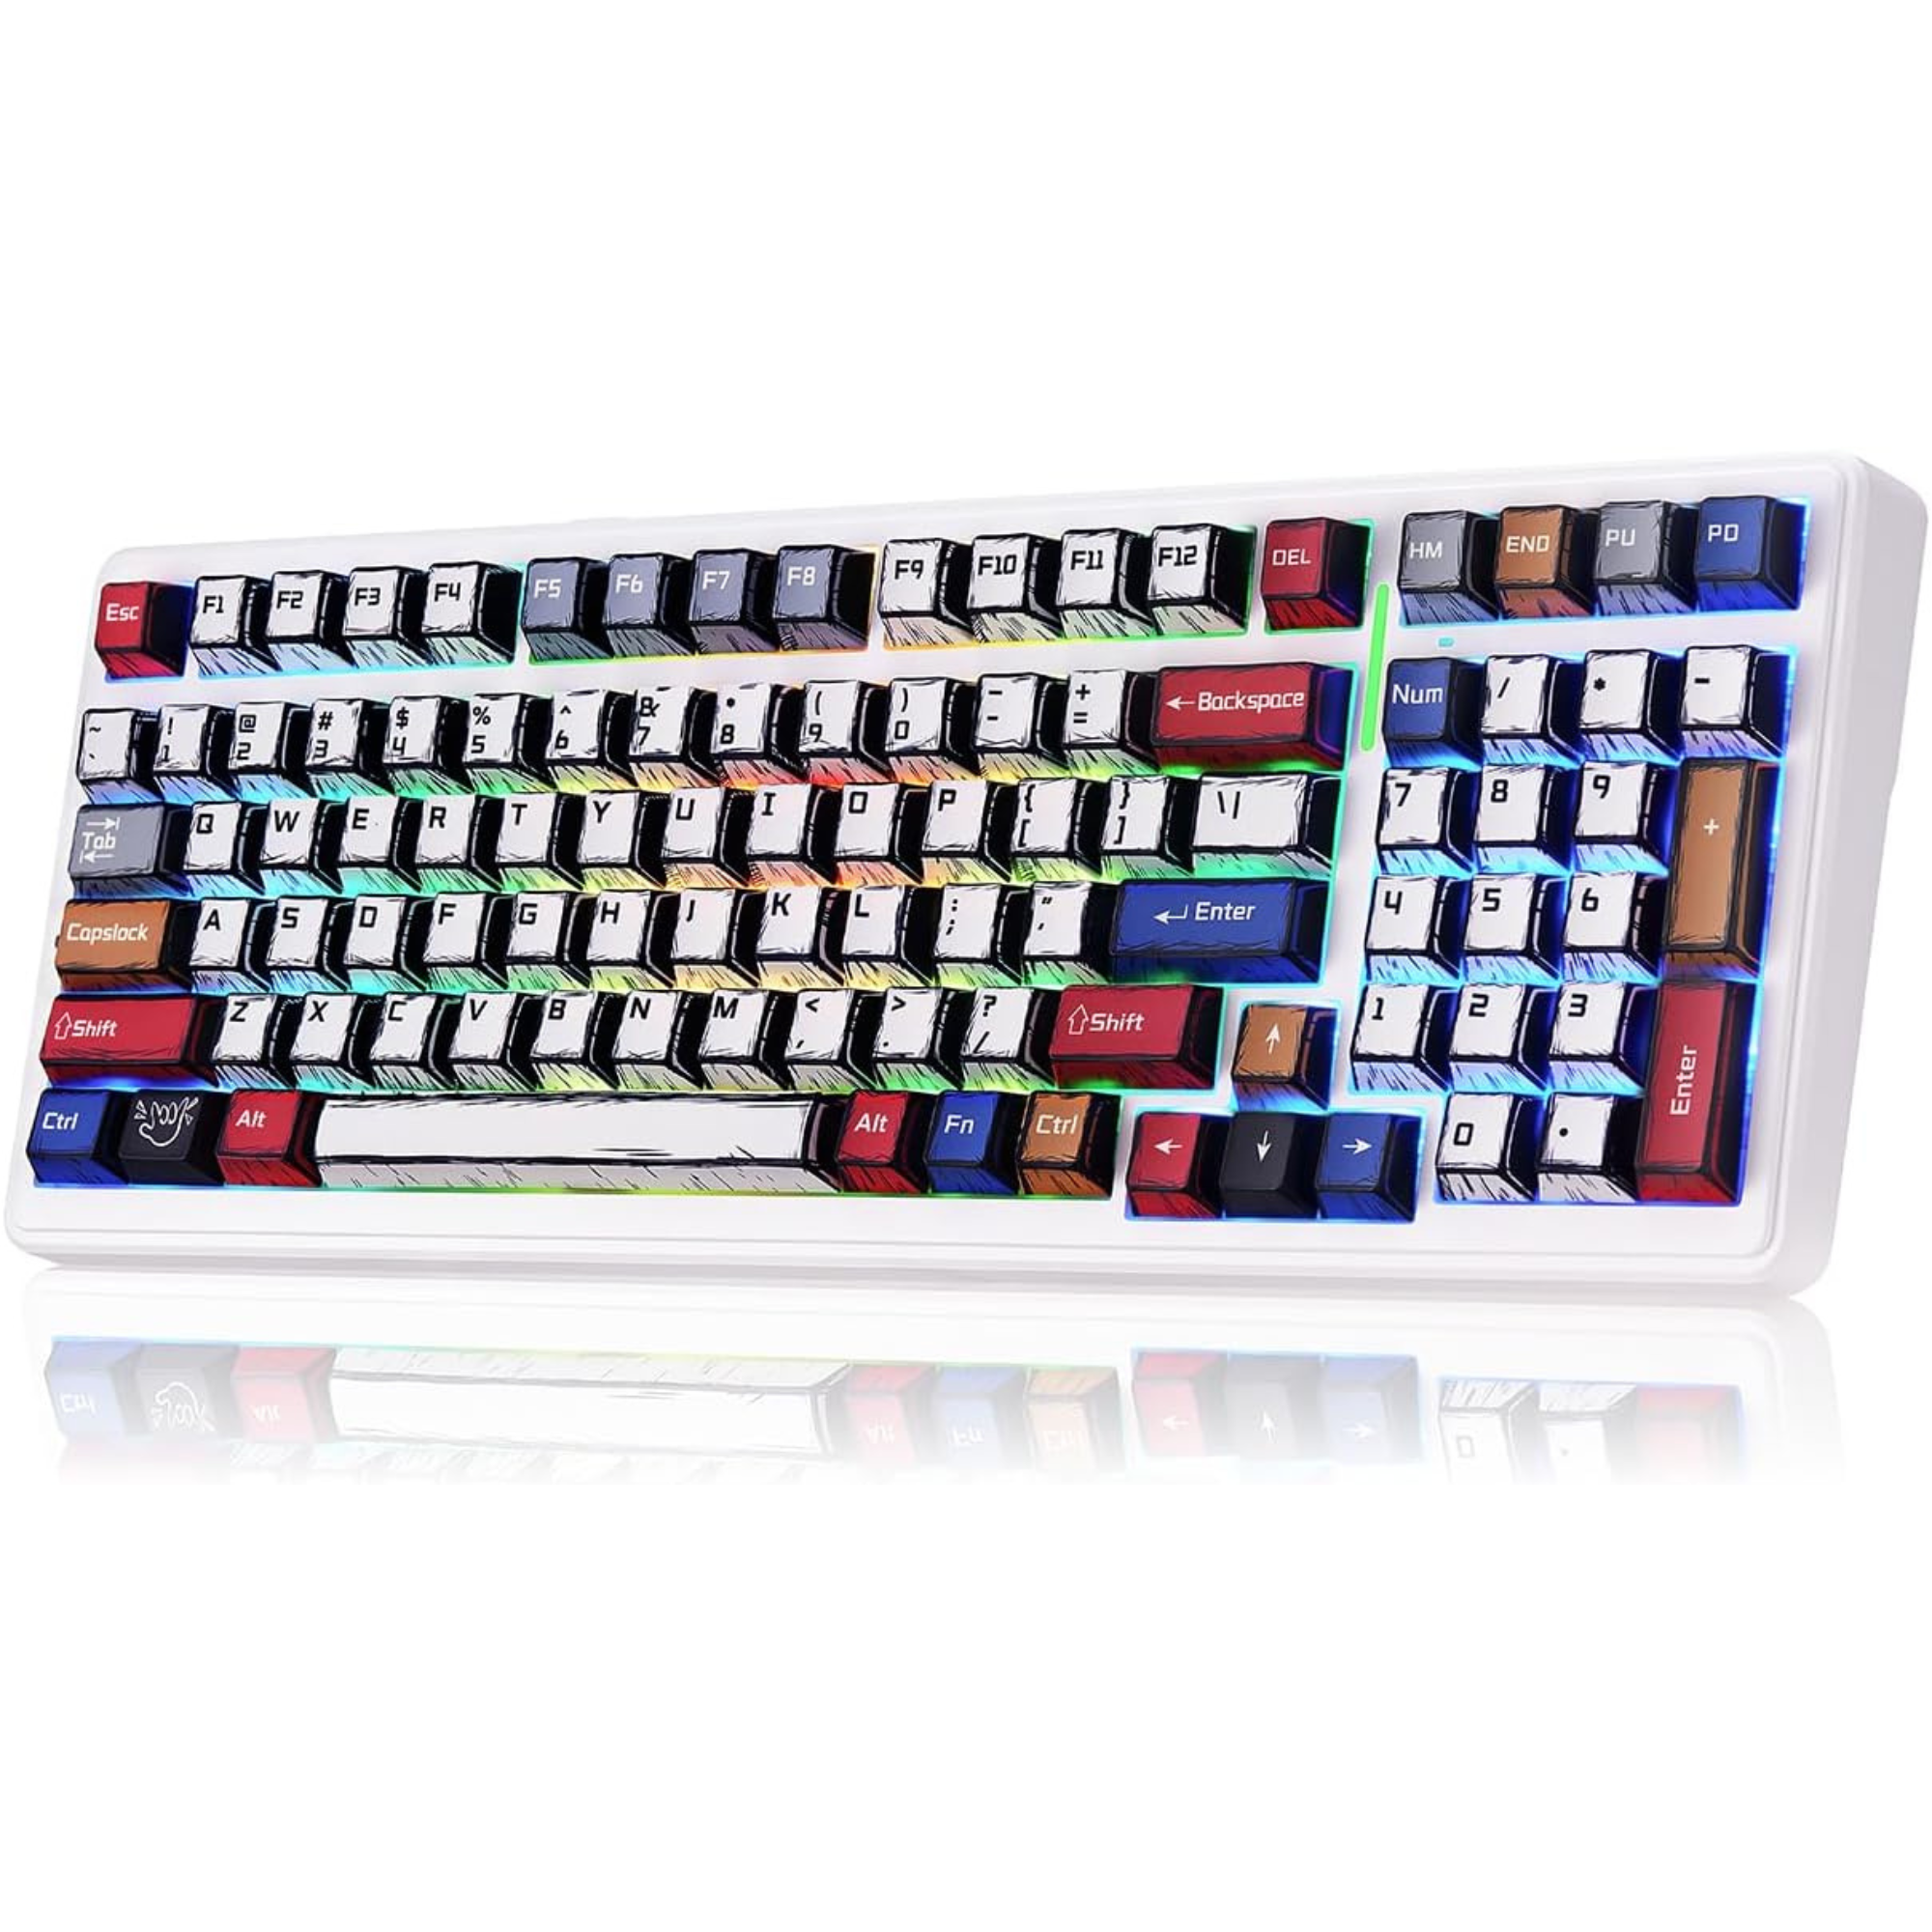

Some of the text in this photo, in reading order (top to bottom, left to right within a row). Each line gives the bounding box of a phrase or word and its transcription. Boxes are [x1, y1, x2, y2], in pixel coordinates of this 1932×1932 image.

[1605, 528, 1635, 546] PU
[1708, 525, 1739, 541] PD
[1409, 541, 1443, 558] HM
[1507, 535, 1549, 553] END
[978, 554, 1016, 575] F10
[1071, 551, 1103, 570] F11
[1158, 546, 1197, 566] F12
[1273, 549, 1311, 565] DEL
[703, 571, 730, 589] F7
[787, 566, 815, 585] F8
[895, 560, 923, 580] F9
[435, 582, 461, 602] F4
[534, 579, 561, 598] F5
[616, 575, 643, 593] F6
[203, 596, 223, 613] F1
[276, 591, 303, 609] F2
[355, 587, 381, 606] F3
[106, 604, 139, 621] Esc
[1199, 691, 1304, 713] Backspace
[1393, 684, 1443, 703] Num
[554, 730, 569, 749] 6
[637, 727, 650, 744] 7
[720, 724, 734, 744] 8
[809, 724, 822, 742] 9
[161, 746, 170, 761] 1
[236, 742, 251, 760] 2
[312, 740, 328, 760] 3
[392, 737, 406, 754] 4
[471, 735, 486, 753] 5
[1395, 782, 1411, 807] 7
[1491, 780, 1508, 803] 8
[1593, 775, 1610, 798] 9
[676, 798, 695, 820] U
[762, 792, 776, 815] I
[849, 791, 867, 813] O
[938, 789, 956, 811] P
[274, 810, 299, 832] W
[353, 809, 369, 830] E
[429, 807, 446, 828] R
[512, 804, 527, 825] T
[593, 801, 611, 823] Y
[193, 813, 213, 834] Q
[82, 832, 116, 849] Tab
[772, 893, 791, 916] K
[855, 895, 869, 917] L
[1384, 891, 1402, 914] 4
[1483, 889, 1501, 911] 5
[1581, 888, 1599, 911] 6
[203, 909, 220, 930] A
[281, 907, 299, 928] S
[359, 906, 377, 927] D
[439, 903, 456, 924] F
[519, 903, 537, 924] G
[601, 901, 620, 923] H
[687, 900, 695, 922] J
[1195, 902, 1256, 920] Enter
[67, 923, 148, 945] Capslock
[230, 1002, 248, 1022] Z
[308, 1001, 328, 1022] X
[388, 1001, 407, 1021] C
[470, 999, 487, 1020] V
[549, 999, 566, 1020] B
[630, 997, 651, 1019] N
[713, 996, 738, 1018] M
[1373, 998, 1383, 1020] 1
[1469, 993, 1489, 1017] 2
[1568, 994, 1587, 1017] 3
[71, 1020, 117, 1037] Shift
[1090, 1013, 1144, 1031] Shift
[1670, 1045, 1696, 1115] Enter
[43, 1113, 78, 1129] Ctrl
[236, 1110, 266, 1127] Alt
[855, 1113, 888, 1132] Alt
[945, 1115, 974, 1133] Fn
[1037, 1115, 1078, 1134] Ctrl
